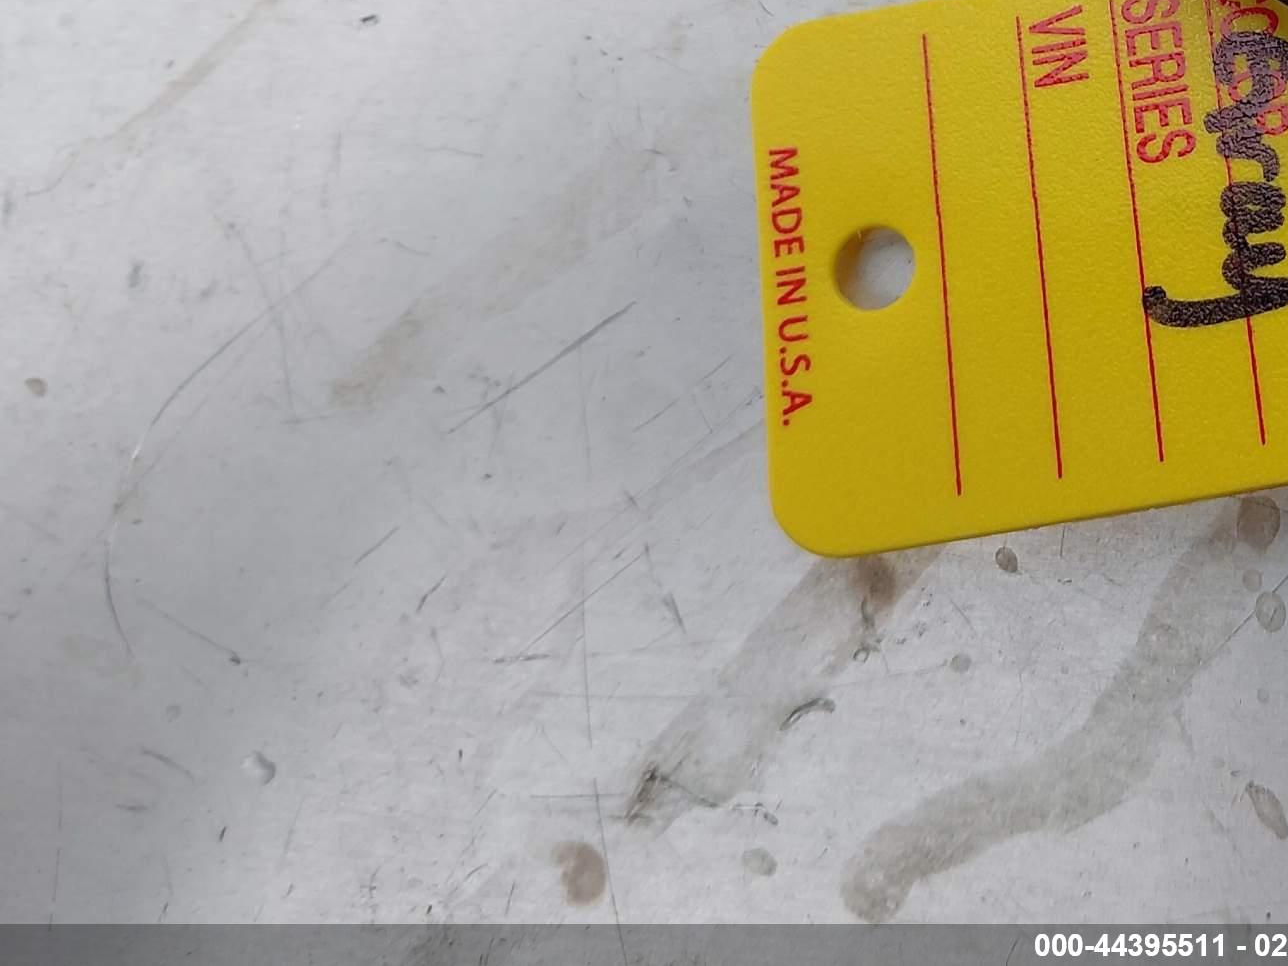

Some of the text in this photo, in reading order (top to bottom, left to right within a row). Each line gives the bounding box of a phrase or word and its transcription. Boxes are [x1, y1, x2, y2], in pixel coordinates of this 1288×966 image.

[1028, 4, 1090, 89] VIN
[768, 146, 814, 427] MADE IN U.S.A.
